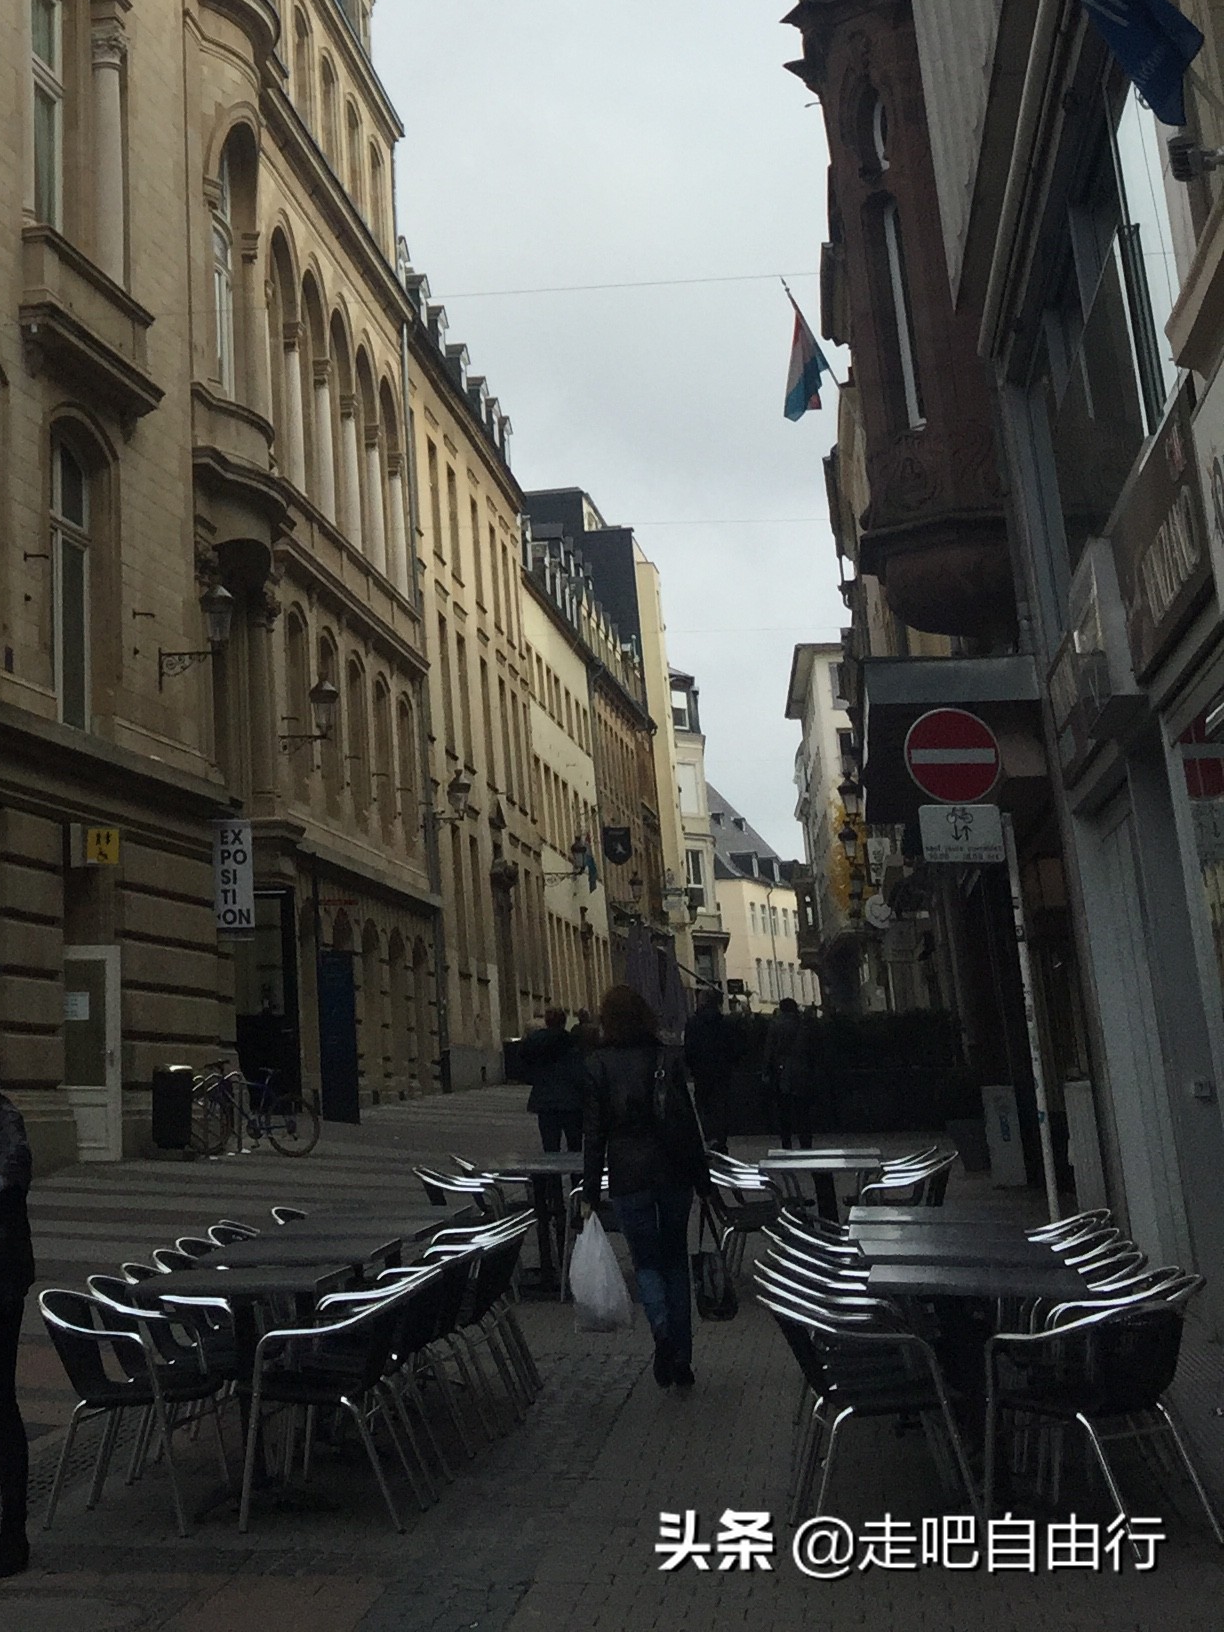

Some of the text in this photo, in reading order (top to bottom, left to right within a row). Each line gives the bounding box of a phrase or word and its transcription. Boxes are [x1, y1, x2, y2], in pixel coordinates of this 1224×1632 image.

[219, 829, 244, 846] EX
[221, 849, 248, 865] PO
[220, 869, 238, 885] SI
[220, 889, 237, 905] TI
[222, 909, 251, 925] ON
